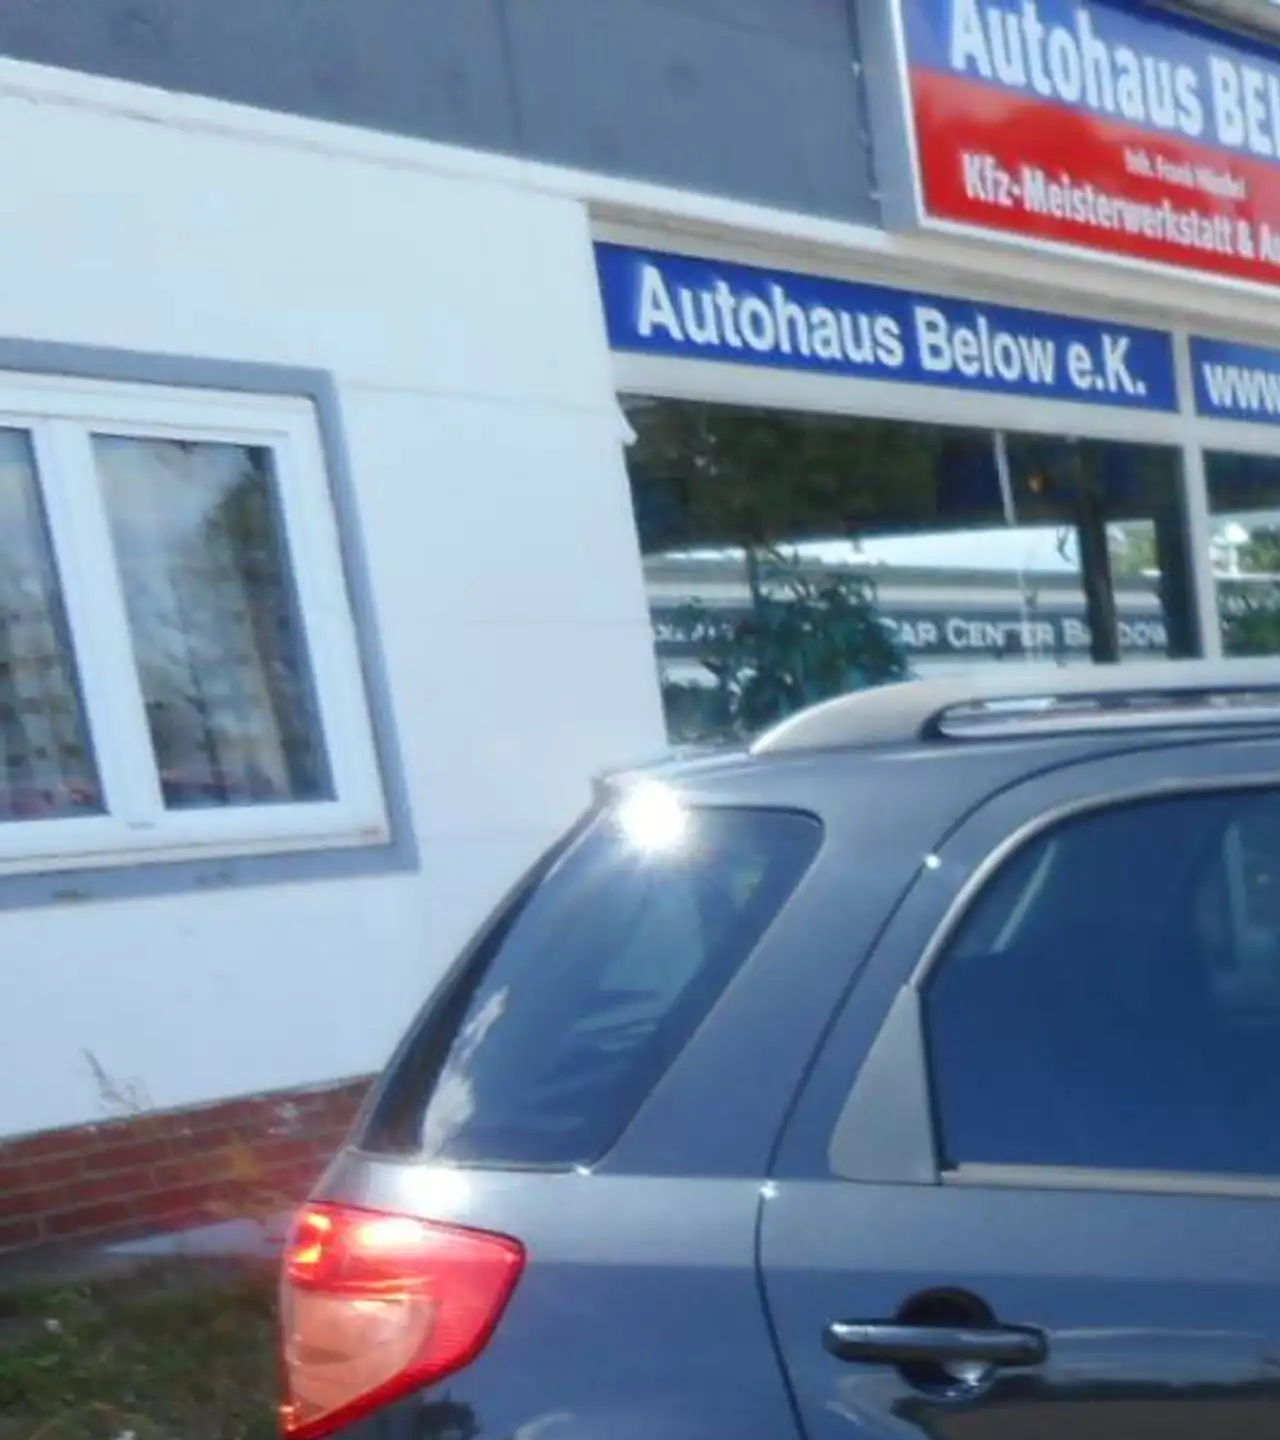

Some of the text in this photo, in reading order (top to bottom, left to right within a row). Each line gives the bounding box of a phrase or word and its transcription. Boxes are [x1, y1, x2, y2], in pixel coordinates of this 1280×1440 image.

[950, 0, 1204, 137] Autohaus
[961, 150, 1233, 256] Kfz-Meisterwerkstatt
[637, 263, 1148, 396] Autohaus Below e.K.
